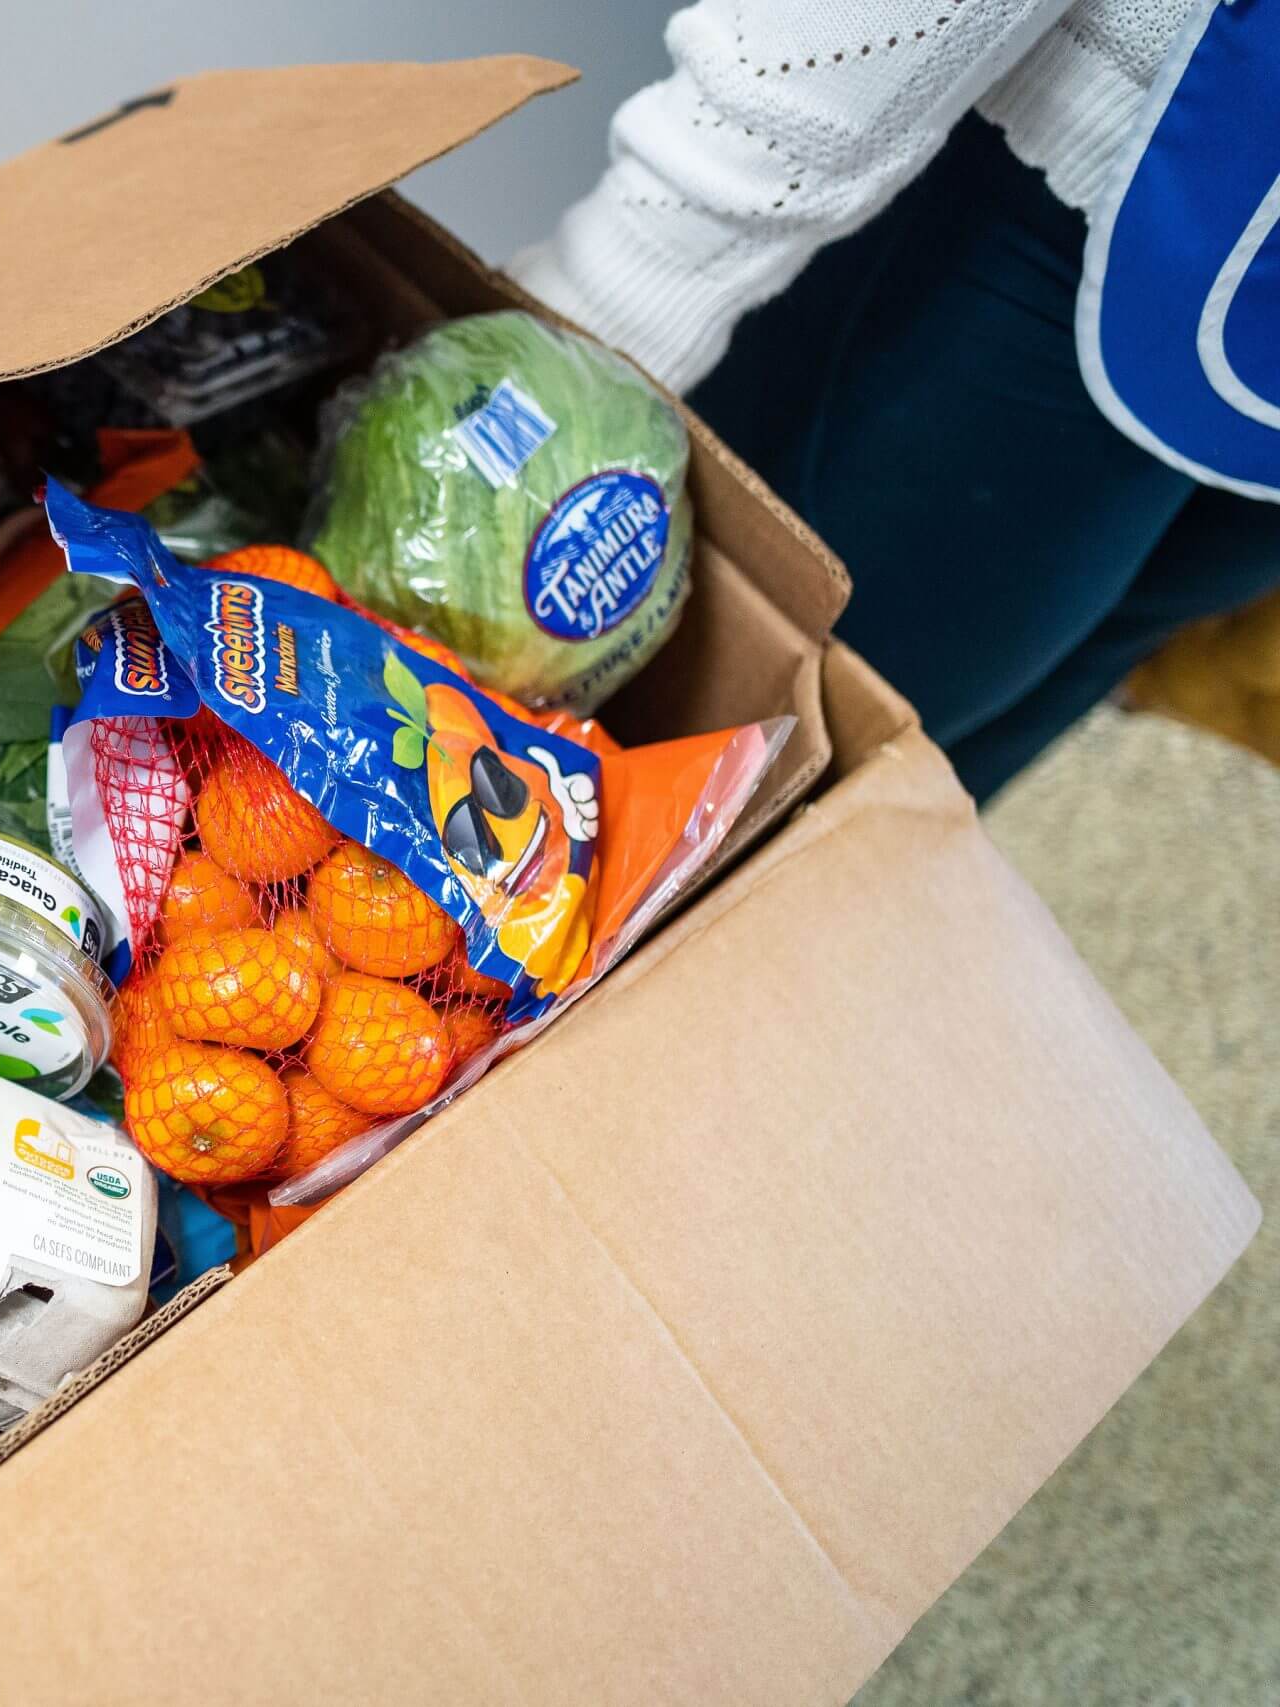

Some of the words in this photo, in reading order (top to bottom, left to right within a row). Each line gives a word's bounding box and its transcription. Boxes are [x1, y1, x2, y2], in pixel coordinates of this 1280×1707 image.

[535, 493, 661, 624] TANIMURA
[588, 531, 662, 638] ANTLE
[96, 1171, 122, 1186] USDA
[32, 1233, 47, 1252] CA
[74, 1247, 132, 1278] COMPLIANT
